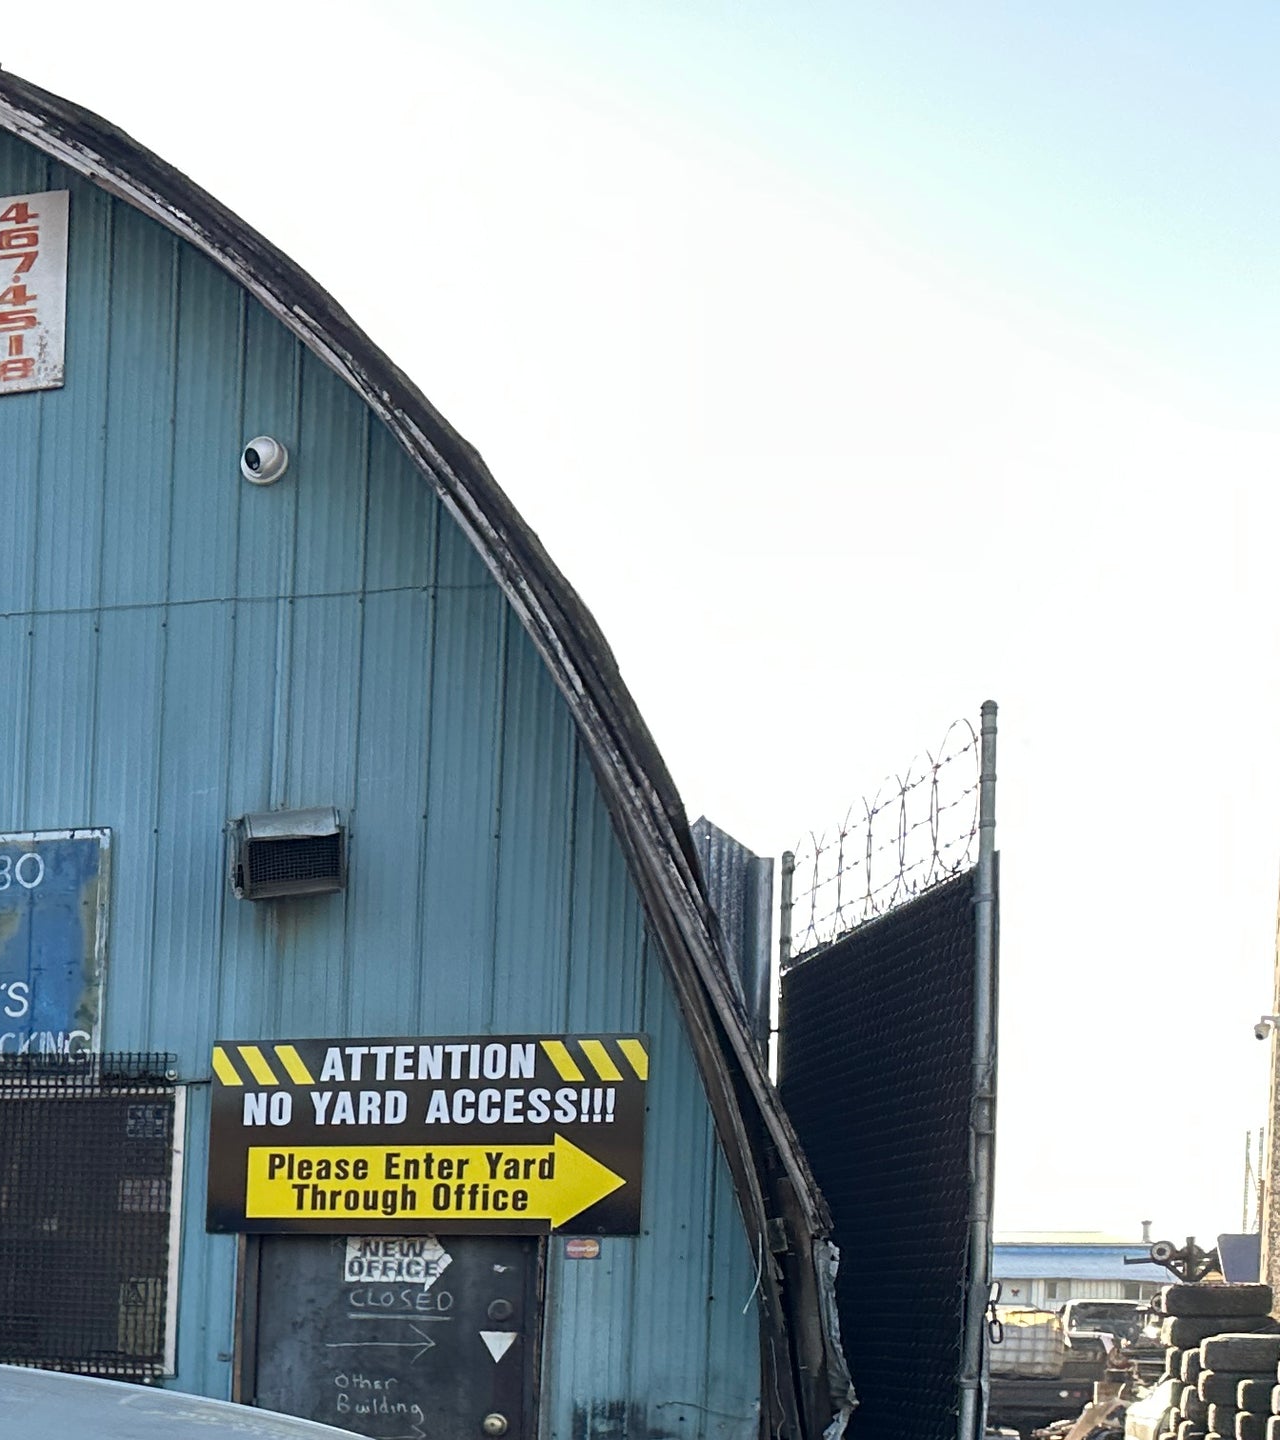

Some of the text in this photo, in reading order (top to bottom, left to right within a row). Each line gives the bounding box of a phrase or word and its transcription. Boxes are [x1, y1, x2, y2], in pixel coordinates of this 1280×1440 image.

[319, 1043, 536, 1082] ATTENTION
[243, 1088, 616, 1126] NO YARD ACCESS!!!
[268, 1151, 556, 1181] Please Enter Yard
[292, 1184, 529, 1216] Through Office
[361, 1239, 425, 1258] NEW
[348, 1257, 439, 1278] OFFICE
[350, 1289, 454, 1311] CLOSED
[334, 1373, 399, 1390] Other
[336, 1393, 425, 1425] Building
